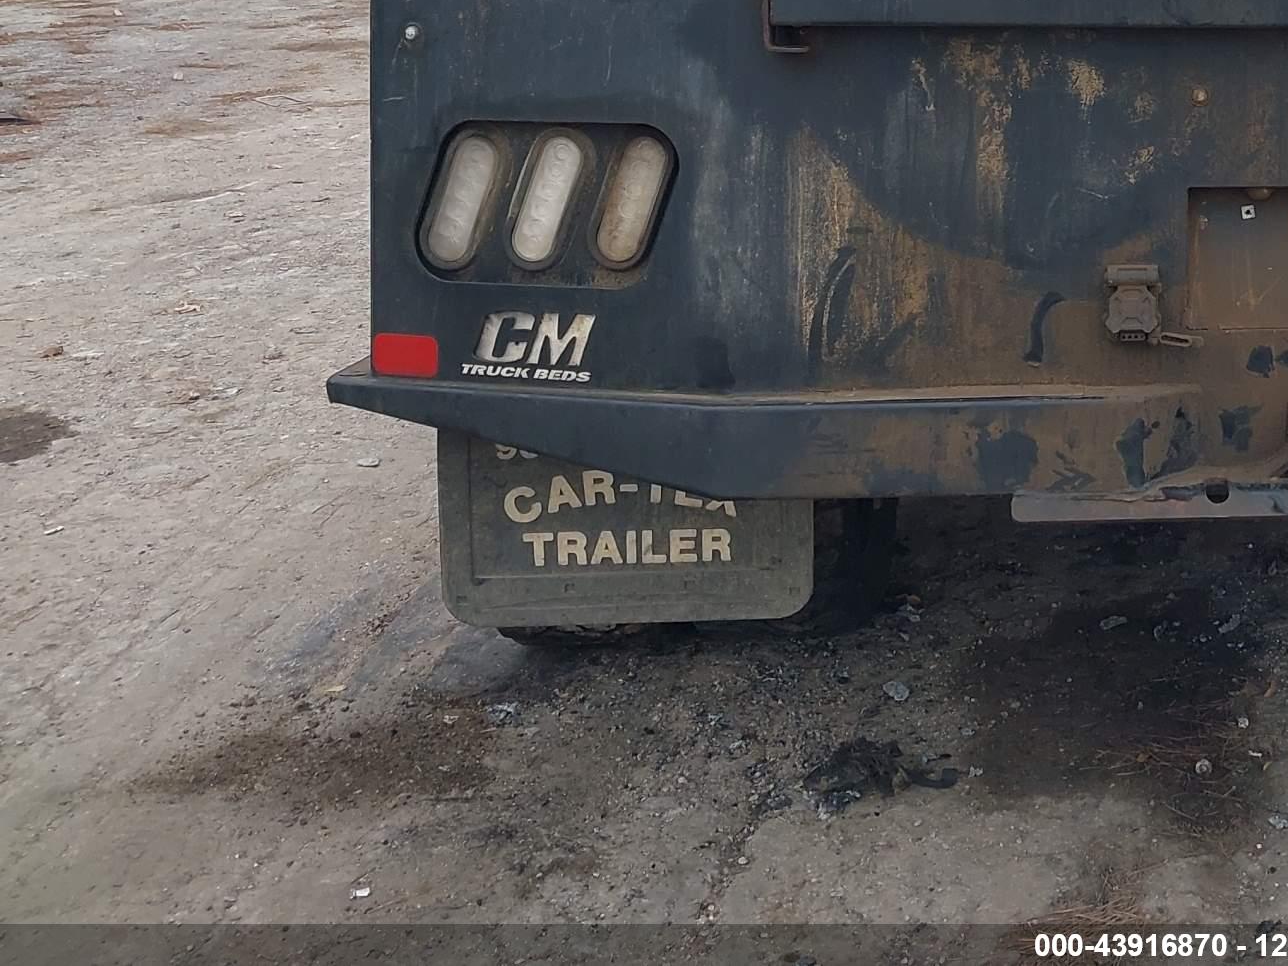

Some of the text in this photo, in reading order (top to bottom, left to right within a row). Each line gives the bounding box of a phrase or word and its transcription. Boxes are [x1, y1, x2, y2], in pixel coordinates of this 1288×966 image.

[474, 311, 597, 366] CM
[461, 363, 592, 383] TRUCK BEDS
[522, 528, 732, 567] TRAILER
